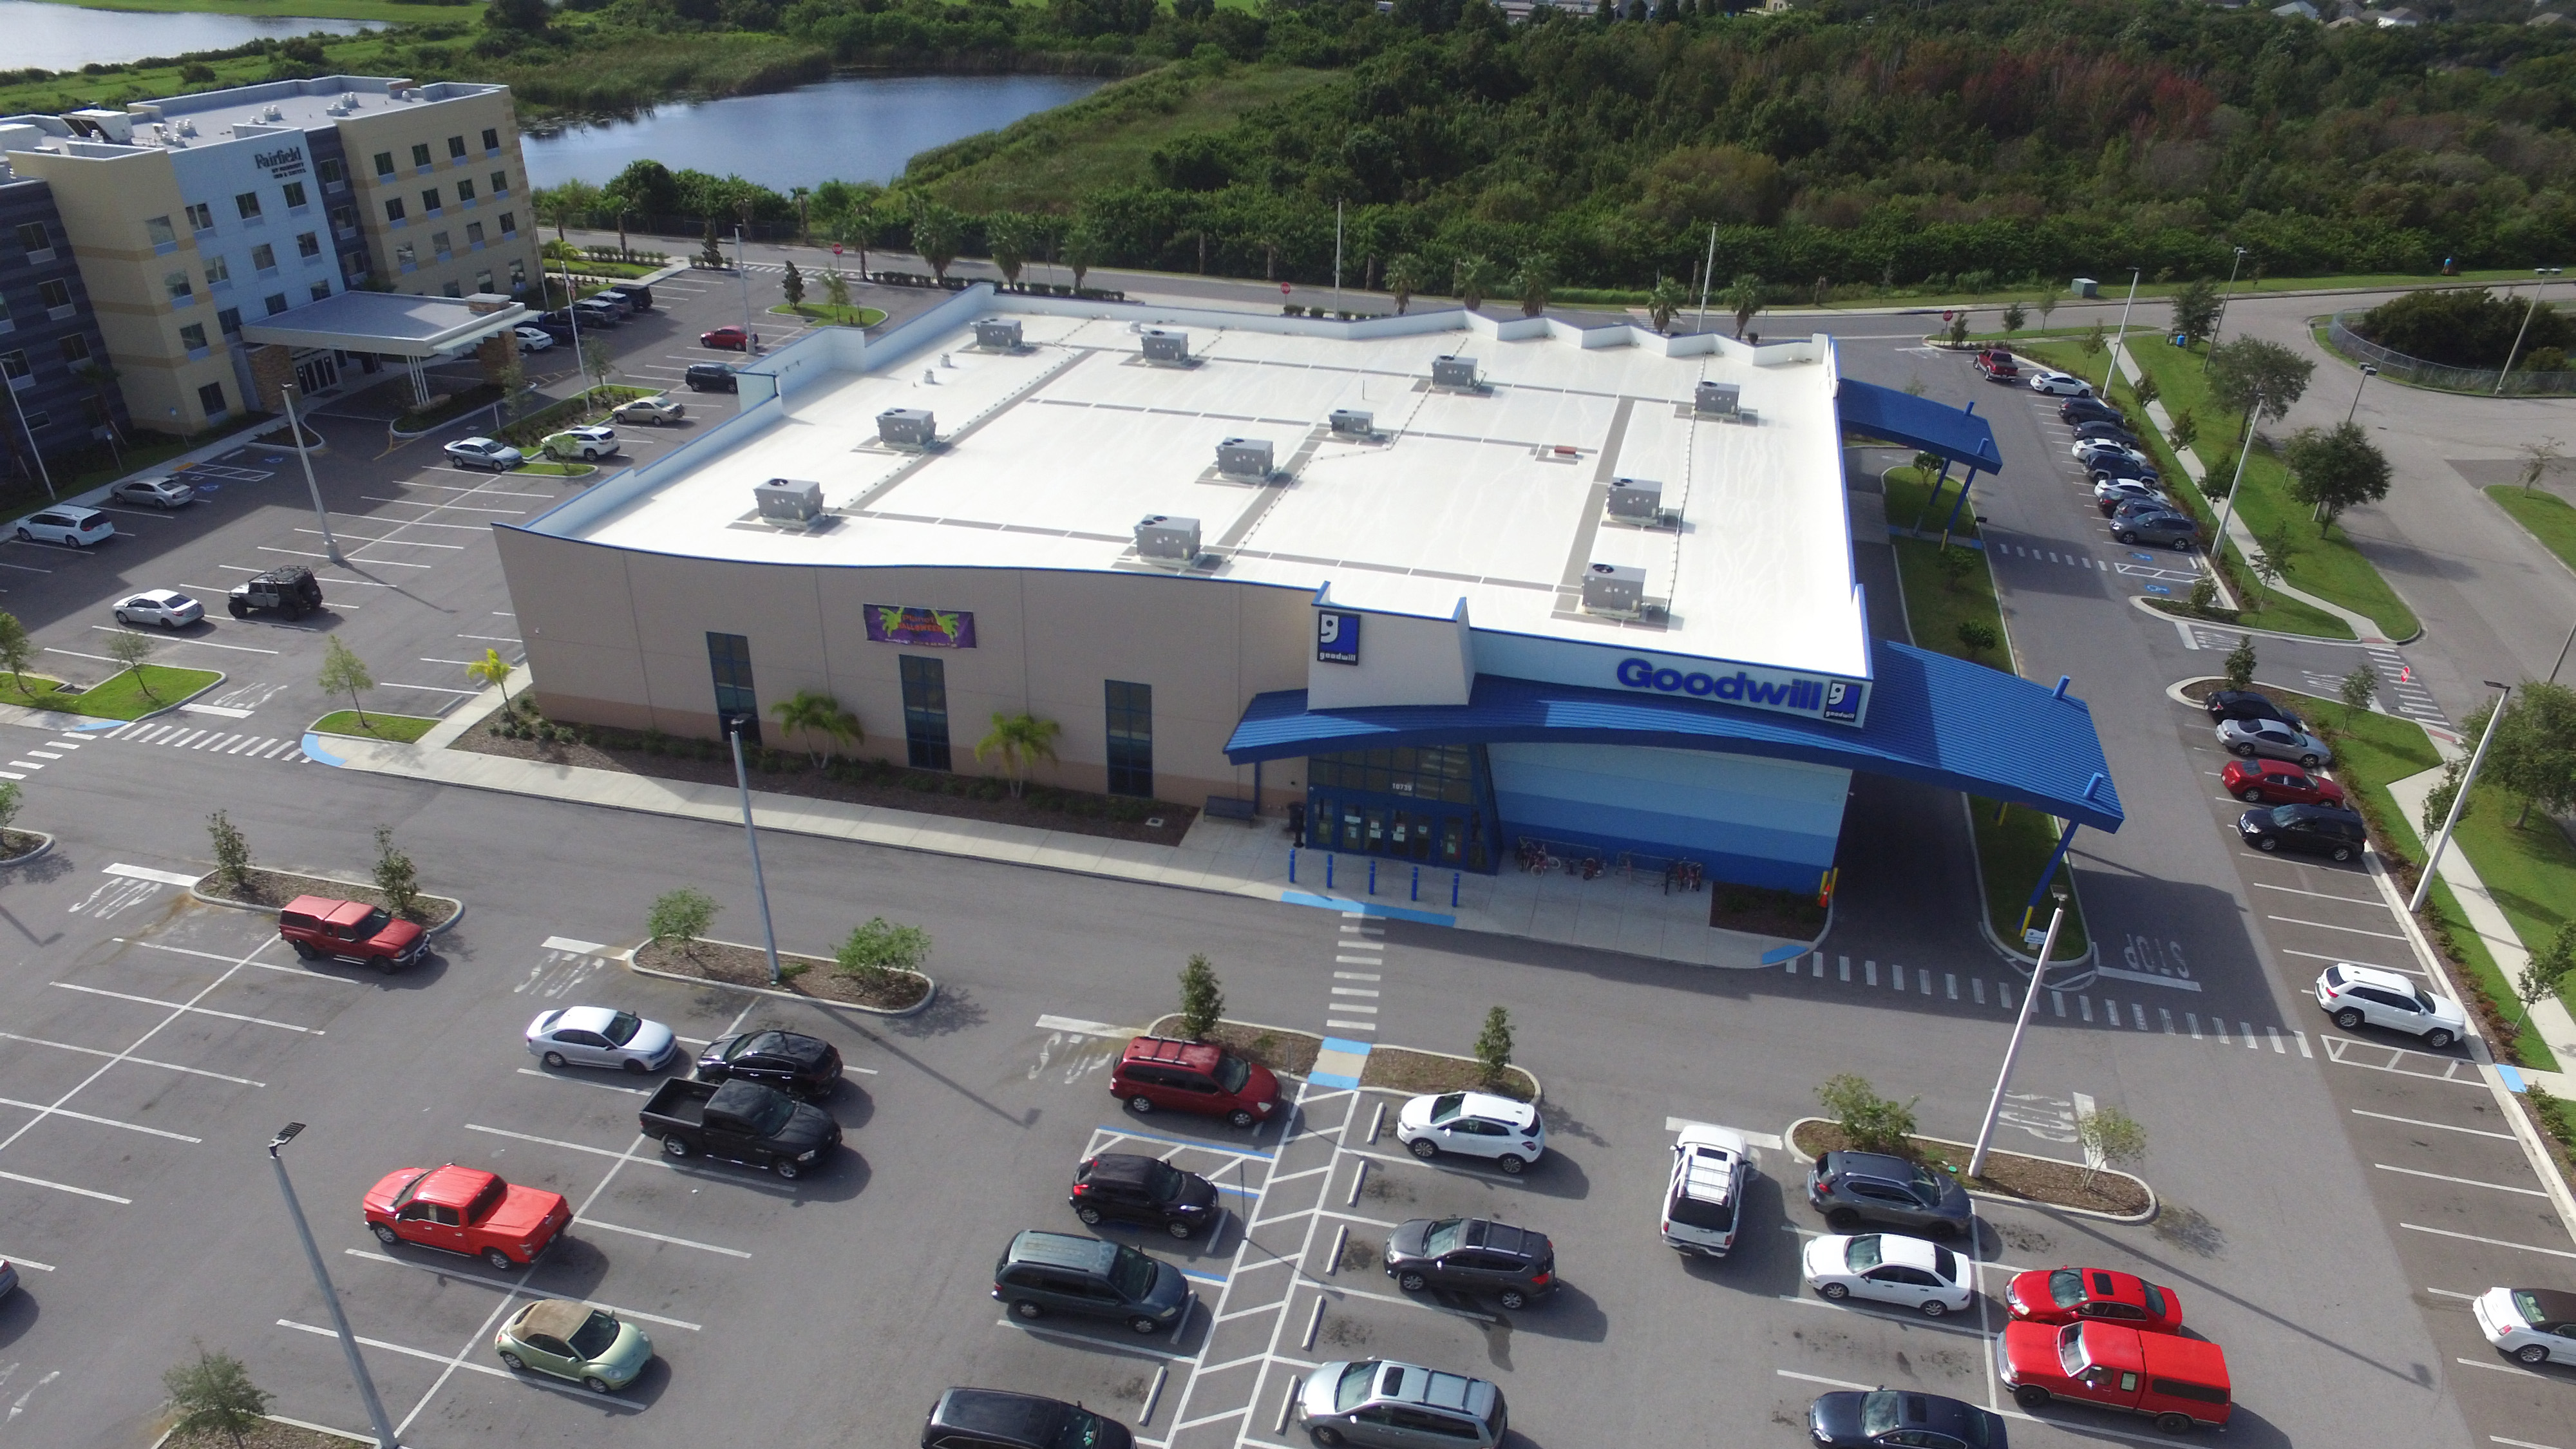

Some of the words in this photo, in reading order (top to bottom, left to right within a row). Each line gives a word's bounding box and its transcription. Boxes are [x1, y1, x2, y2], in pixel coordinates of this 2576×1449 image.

[254, 147, 302, 169] Fairfield
[1320, 652, 1356, 661] goodwill
[213, 683, 288, 709] STOP
[1616, 658, 1823, 711] Goodwill
[1392, 782, 1412, 791] 10739
[68, 877, 162, 920] STOP
[513, 951, 605, 999] STOP
[2123, 933, 2190, 979] STOP
[1991, 1088, 2078, 1143] STOP
